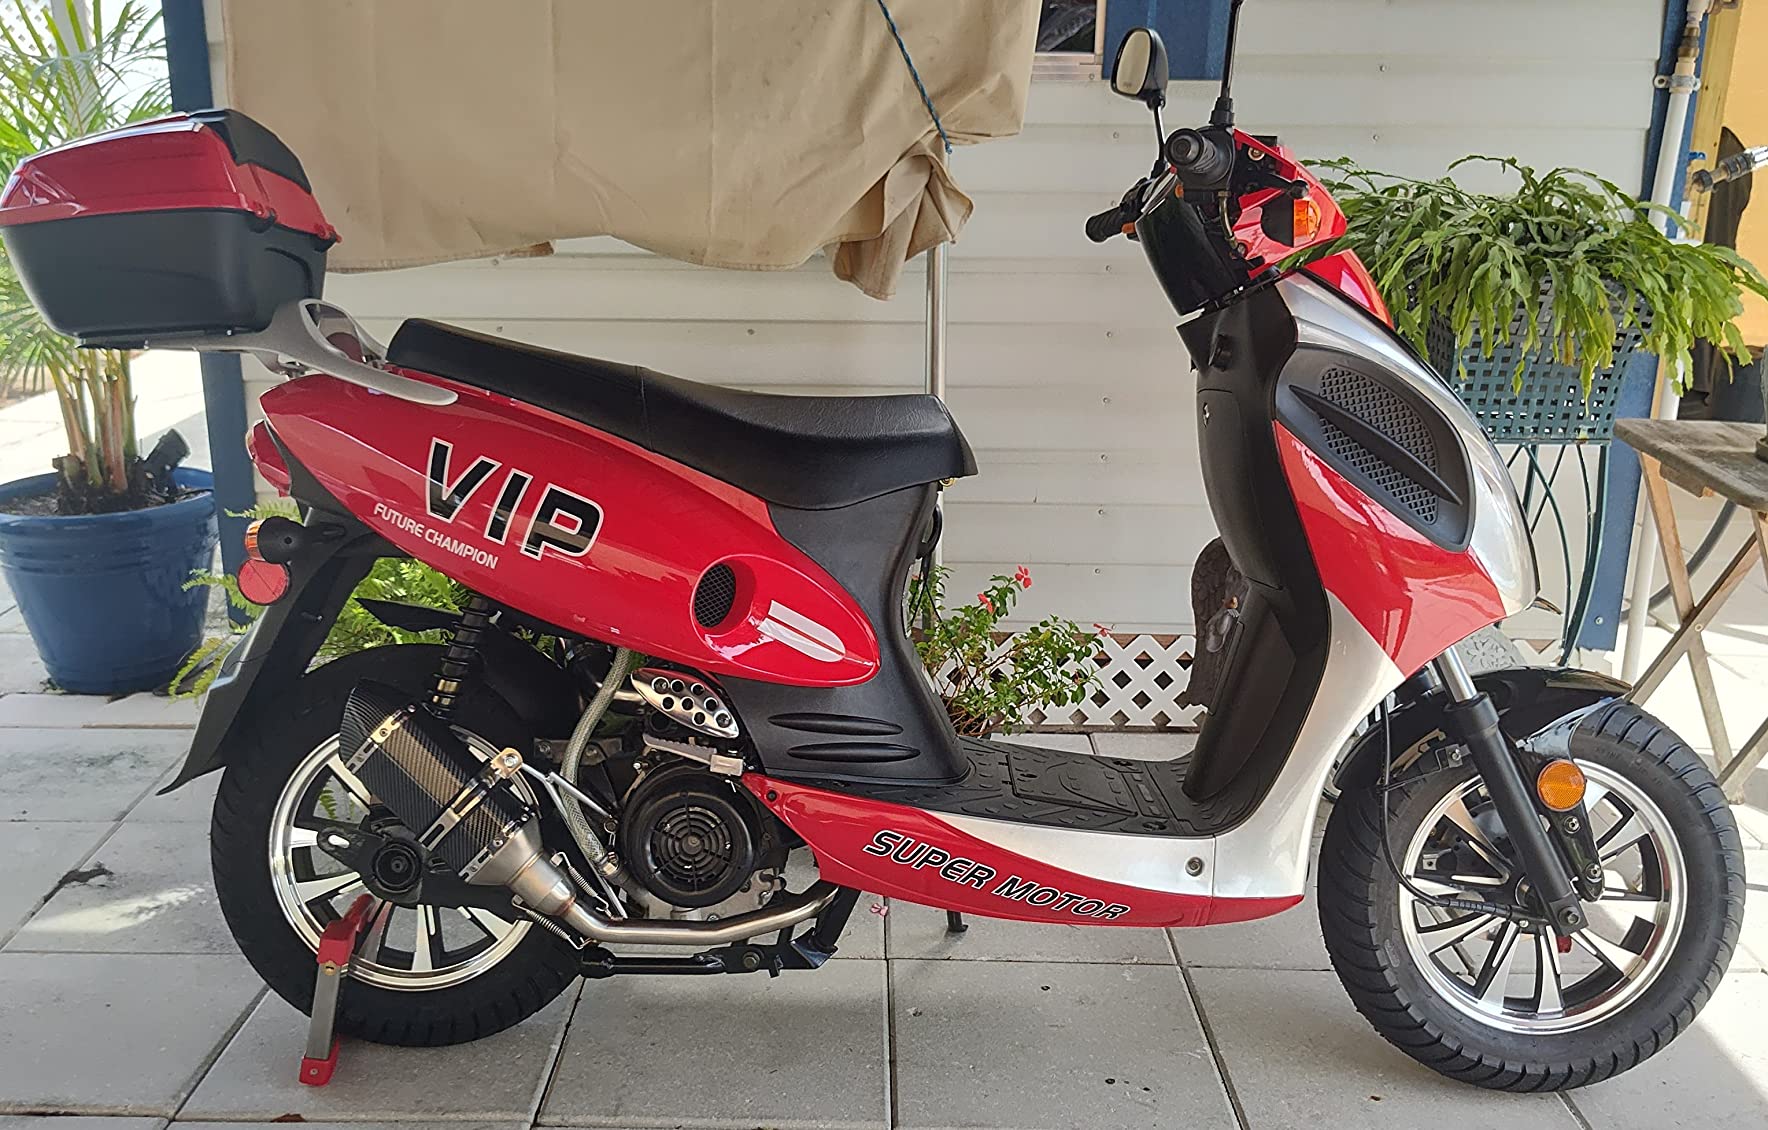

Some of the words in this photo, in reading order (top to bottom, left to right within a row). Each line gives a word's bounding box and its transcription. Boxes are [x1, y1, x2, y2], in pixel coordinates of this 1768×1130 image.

[373, 502, 425, 538] FUTURE
[424, 527, 499, 570] CHAMPION
[425, 437, 604, 560] VIP
[863, 829, 997, 890] SUPER
[991, 875, 1131, 920] MOTOR
